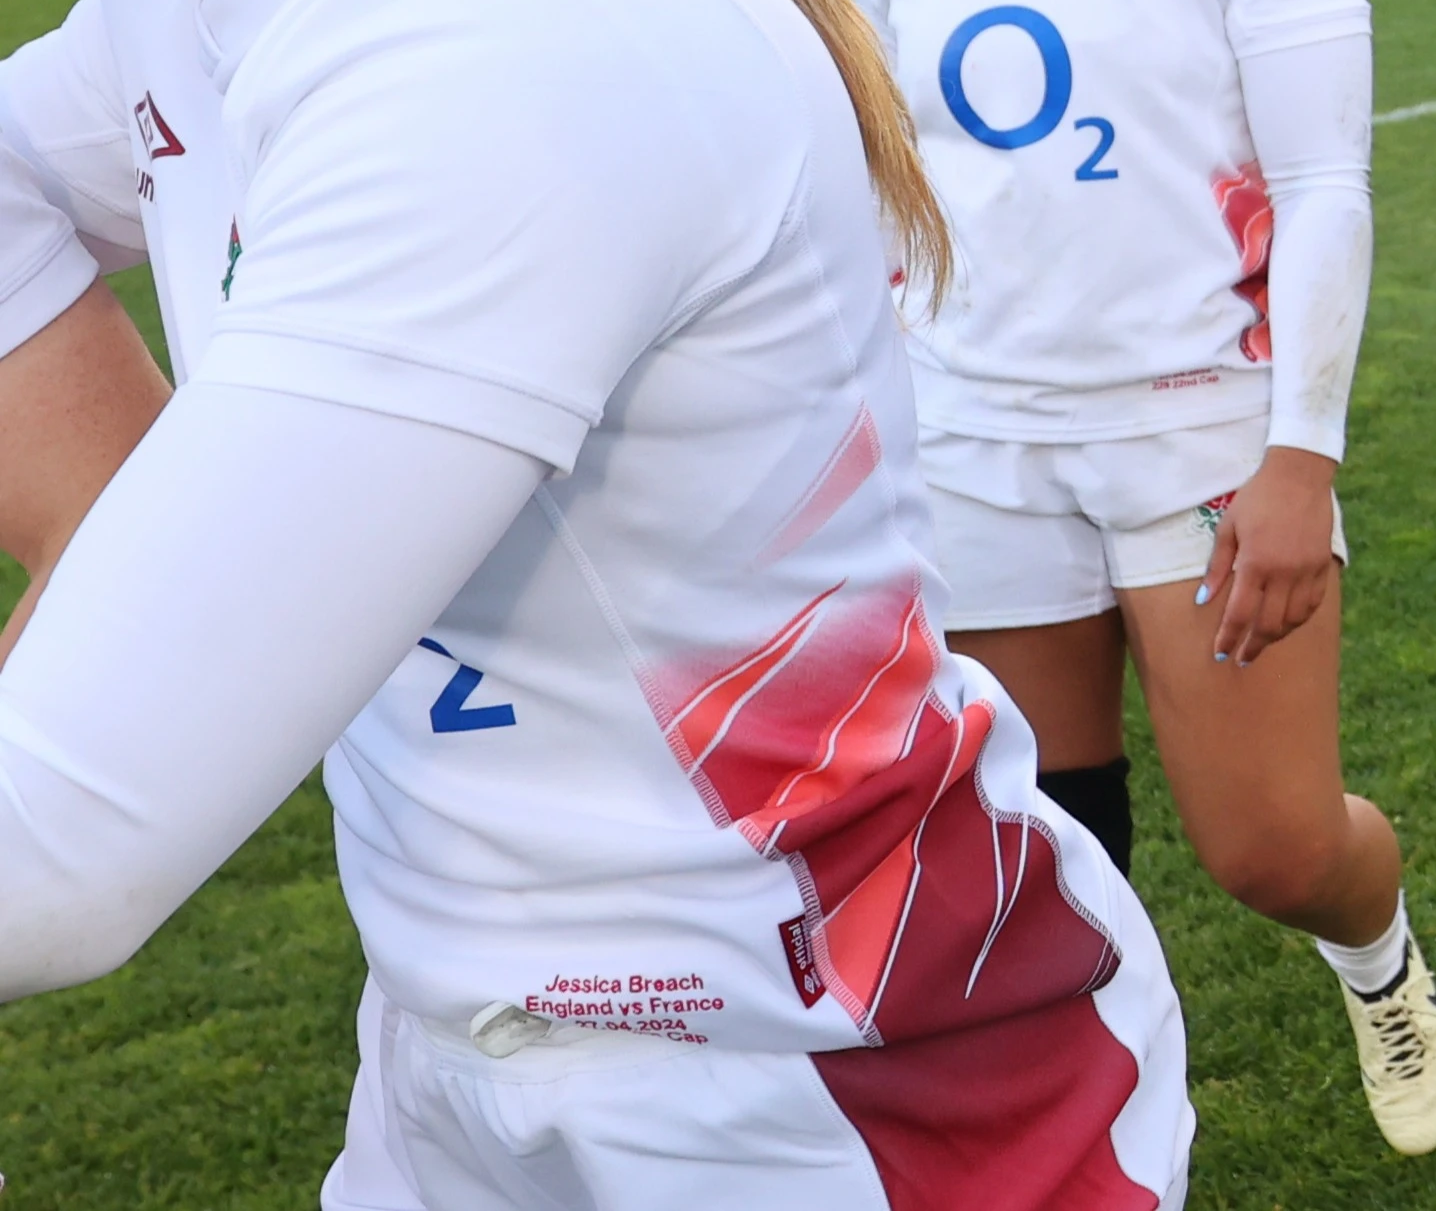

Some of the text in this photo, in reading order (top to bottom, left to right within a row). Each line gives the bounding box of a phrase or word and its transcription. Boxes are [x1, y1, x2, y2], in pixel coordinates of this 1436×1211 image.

[1200, 375, 1219, 385] Cap
[545, 973, 704, 993] Jessica Breach
[525, 996, 724, 1018] England vs France
[667, 1032, 709, 1045] Cap
